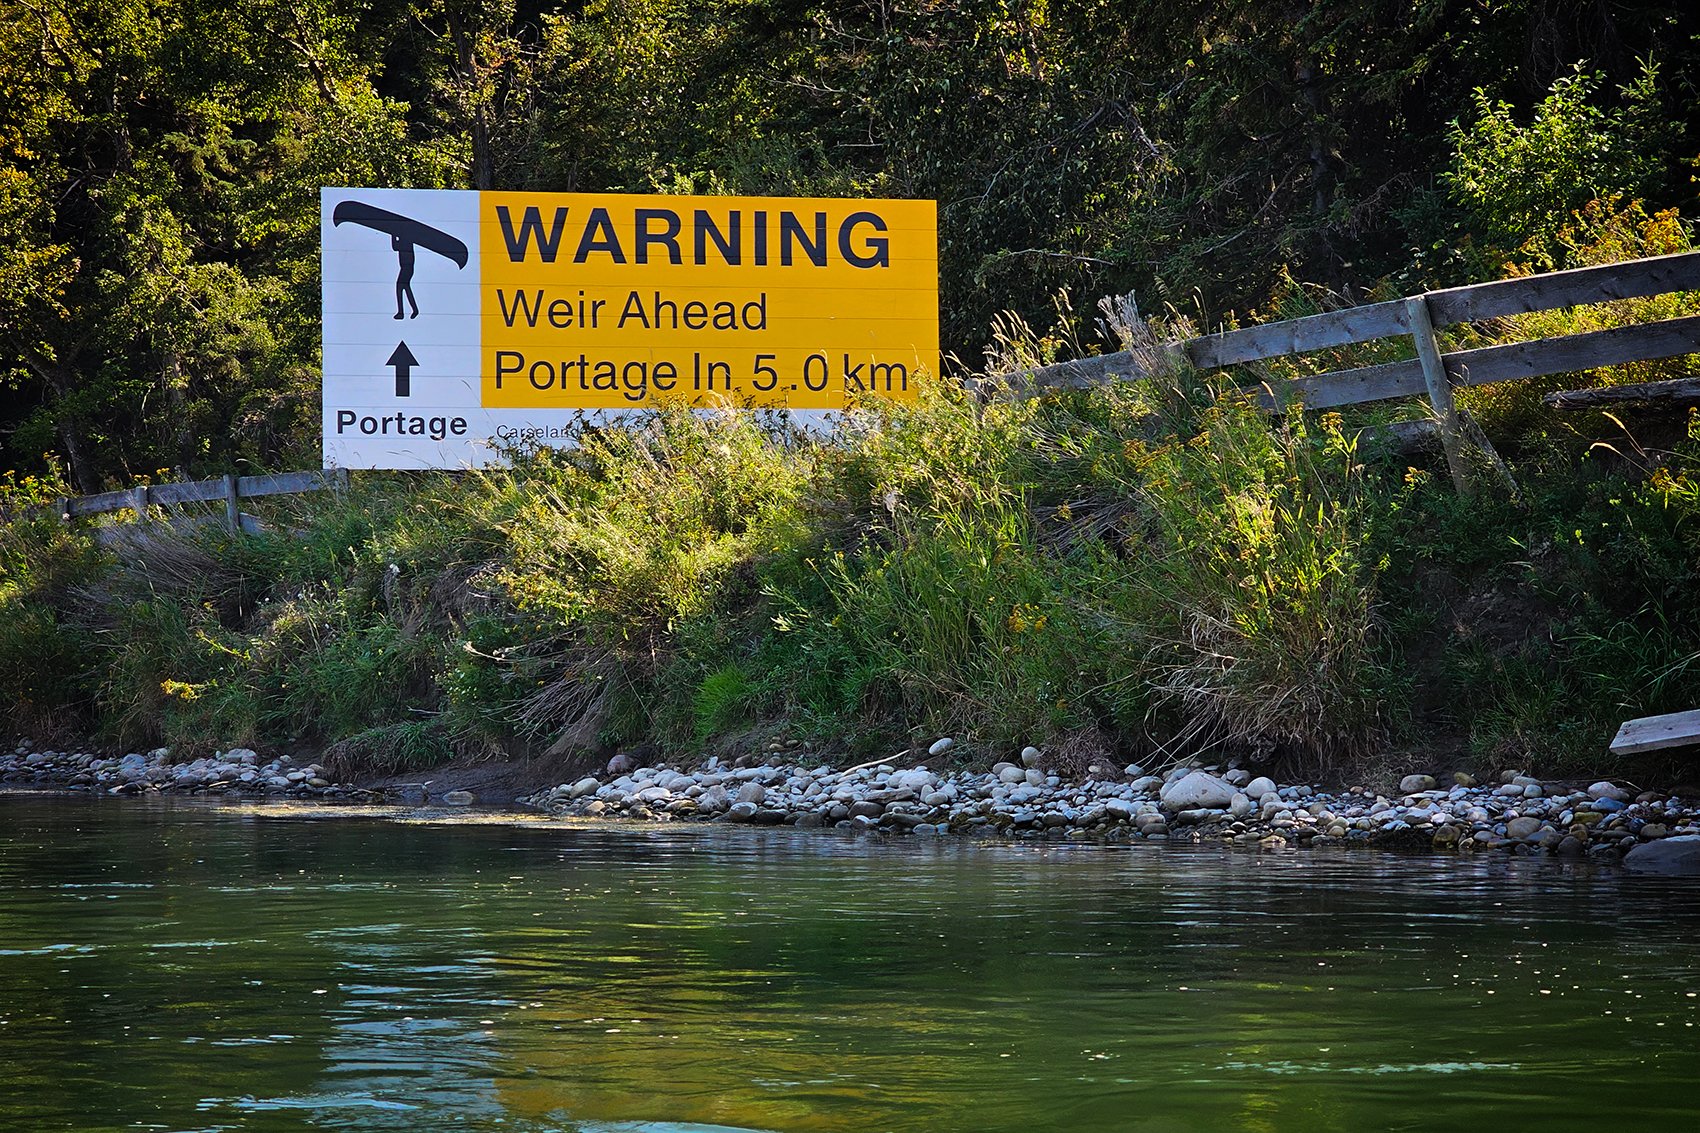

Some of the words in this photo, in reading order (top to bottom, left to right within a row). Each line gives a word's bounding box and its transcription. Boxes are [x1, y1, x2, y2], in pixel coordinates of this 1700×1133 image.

[496, 206, 890, 268] WARNING
[498, 289, 606, 329] Weir
[618, 291, 768, 330] Ahead
[495, 351, 677, 400] Portage
[694, 353, 732, 391] In
[752, 354, 828, 391] 5.0
[843, 354, 908, 392] km
[337, 410, 468, 440] Portage
